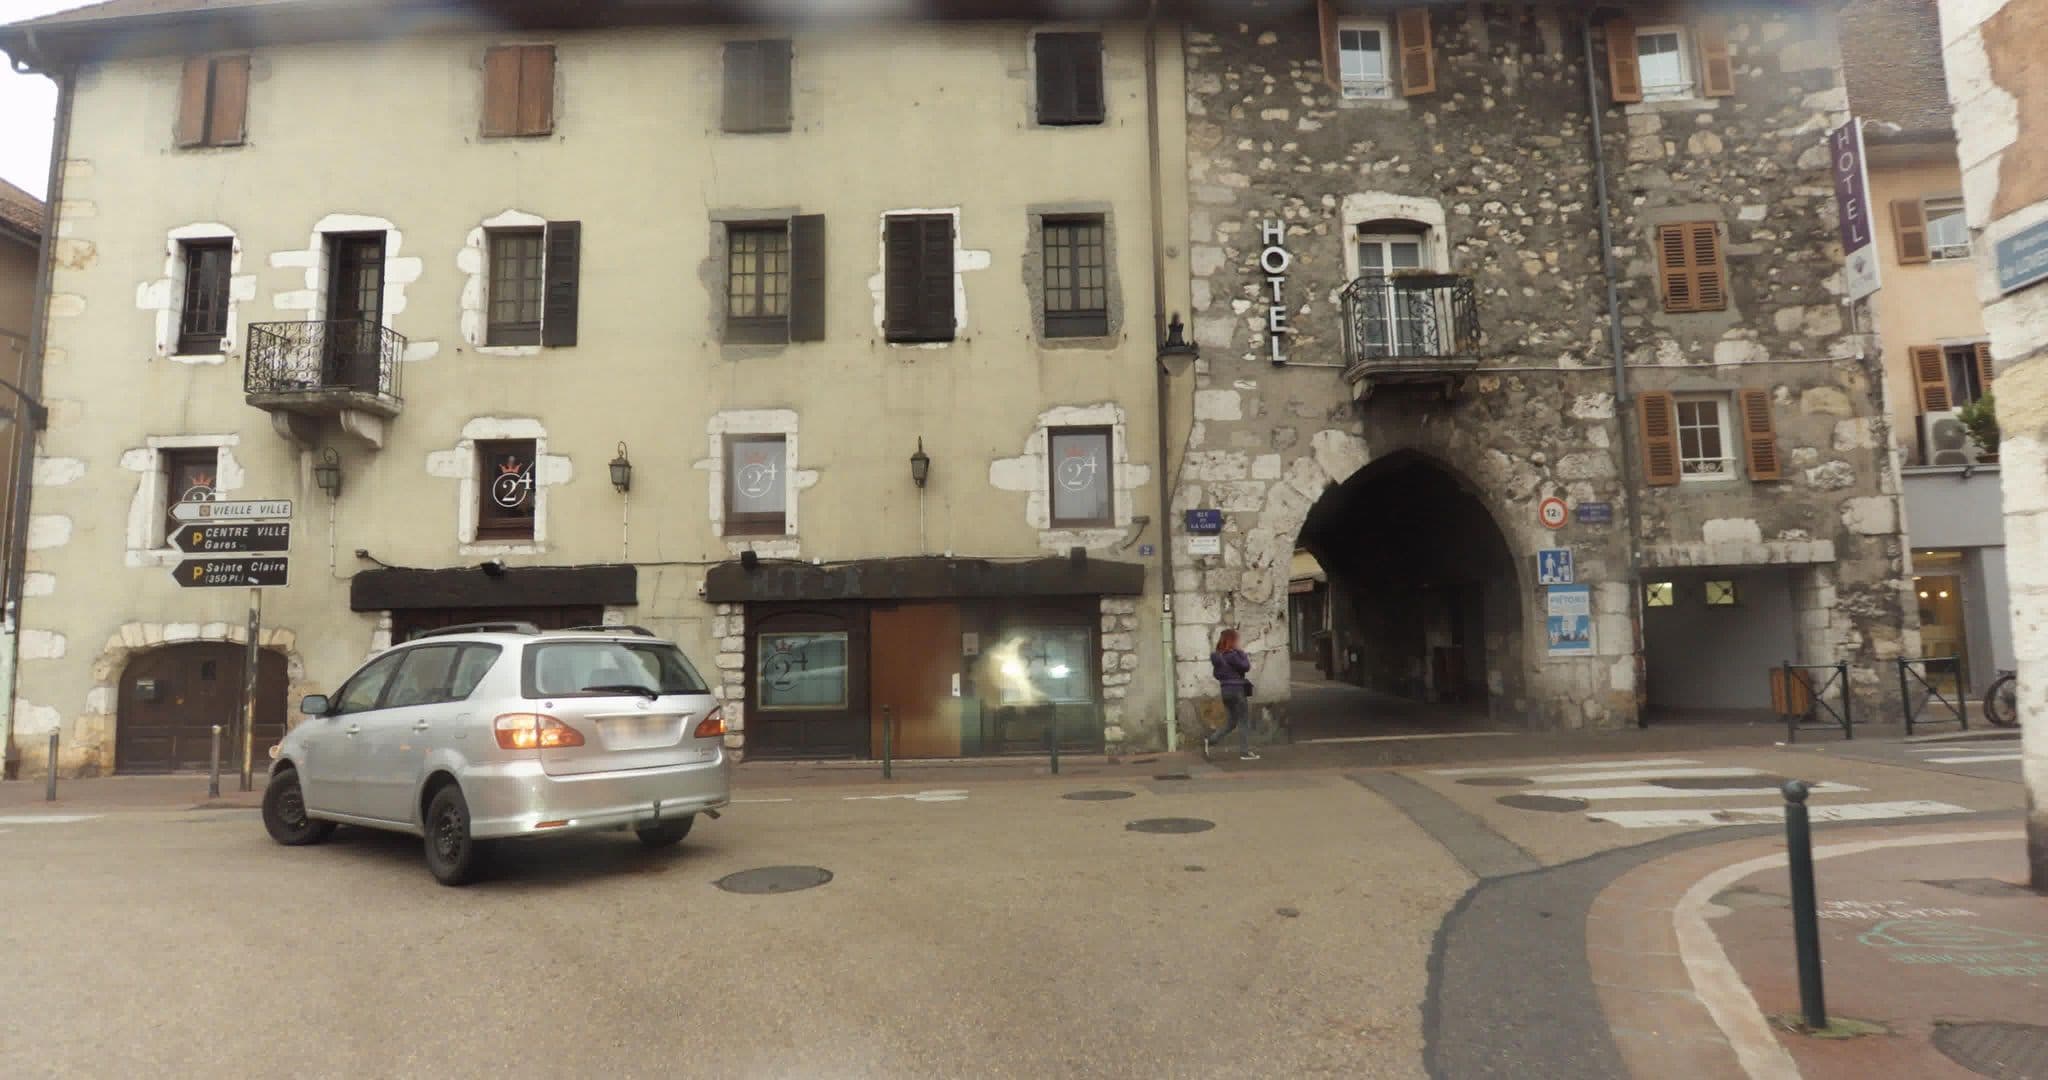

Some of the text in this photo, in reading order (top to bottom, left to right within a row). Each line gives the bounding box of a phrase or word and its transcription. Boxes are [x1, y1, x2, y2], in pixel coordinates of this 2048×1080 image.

[1837, 126, 1865, 244] HOTEL
[1260, 219, 1289, 362] HOTEL
[501, 461, 535, 502] 24
[213, 503, 289, 515] VIEILLE VILLE
[192, 532, 203, 546] P
[205, 526, 288, 538] CENTRE VILLE
[204, 540, 237, 550] Gares
[193, 566, 204, 580] P
[206, 561, 286, 573] Sainte Claire
